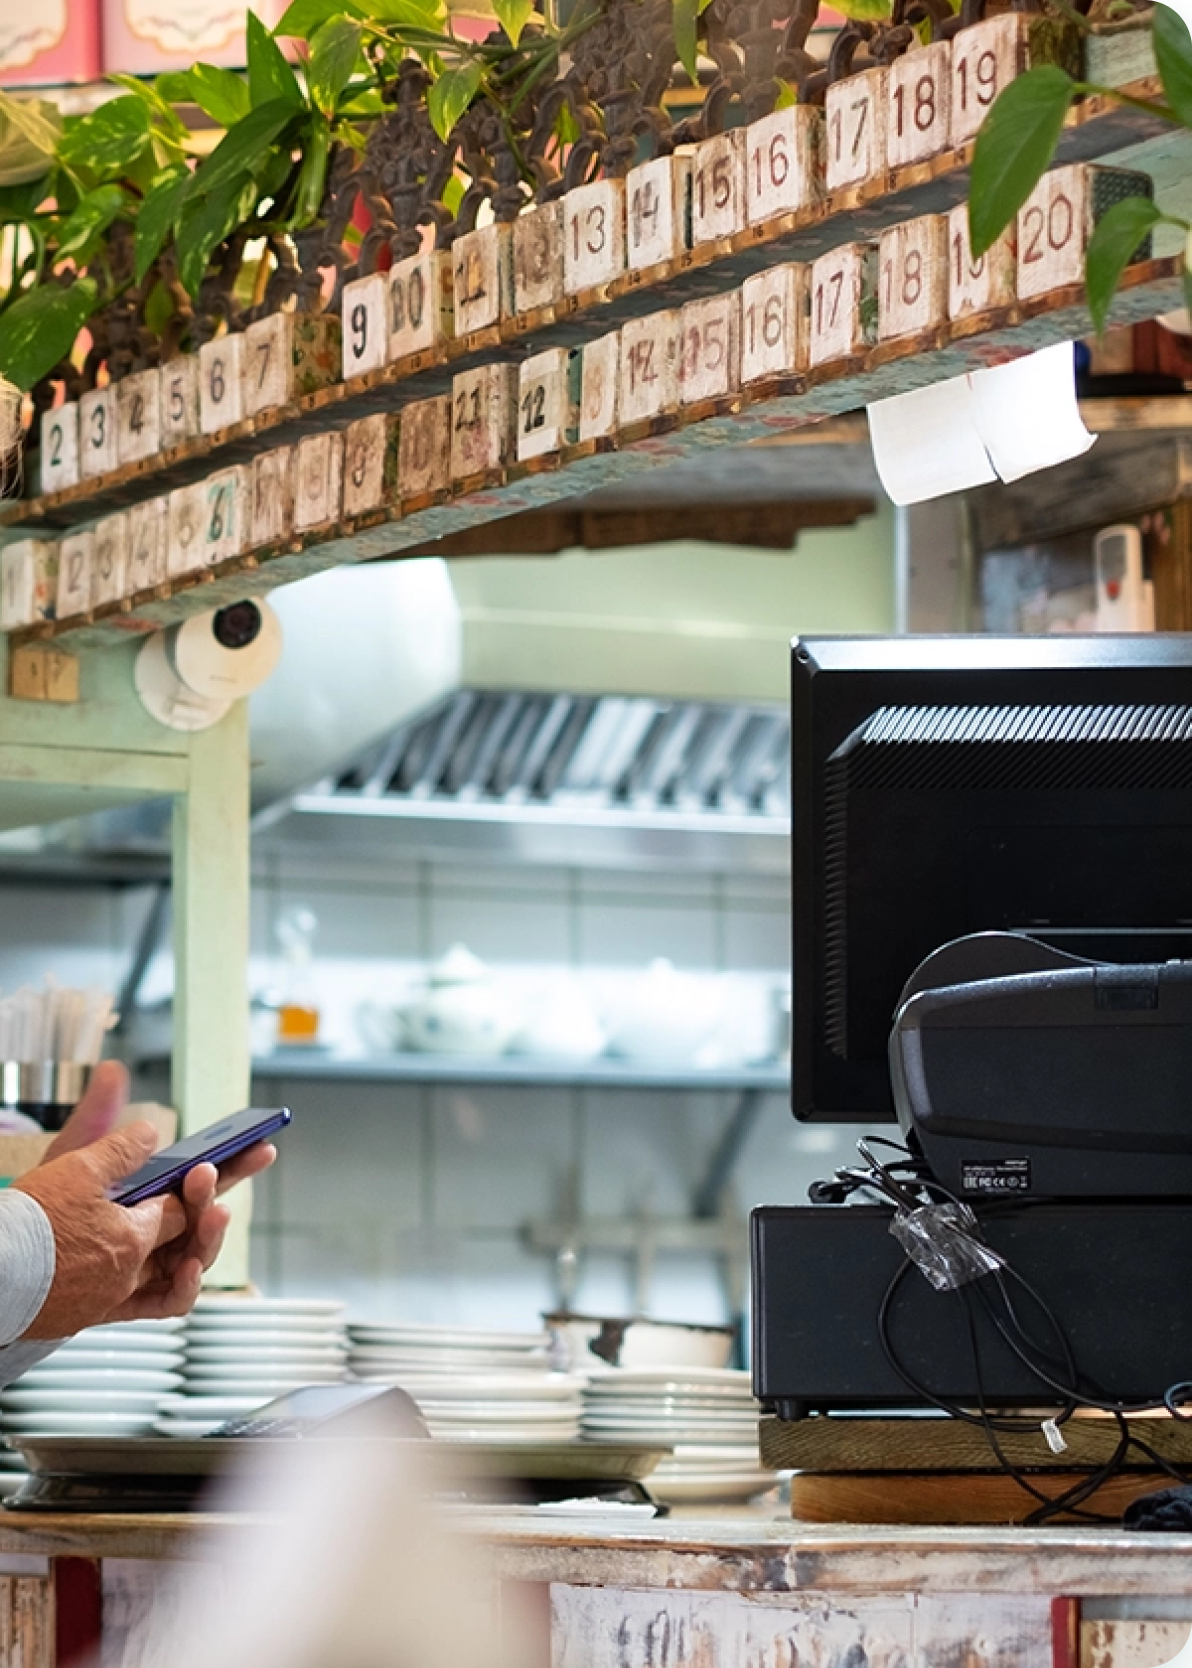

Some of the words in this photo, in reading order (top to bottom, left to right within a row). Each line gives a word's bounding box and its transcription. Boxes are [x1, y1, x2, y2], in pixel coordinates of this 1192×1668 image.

[892, 75, 935, 137] 18
[956, 50, 997, 110] 19
[830, 97, 868, 162] 17
[695, 155, 732, 218] 15
[752, 134, 790, 196] 16
[570, 205, 605, 262] 13
[1022, 194, 1073, 265] 20
[815, 270, 844, 335] 17
[883, 249, 923, 314] 18
[351, 303, 367, 359] 9
[745, 294, 783, 355] 16
[210, 358, 225, 404] 6
[257, 343, 272, 390] 7
[90, 404, 106, 449] 3
[129, 395, 144, 436] 4
[170, 378, 184, 422] 5
[456, 382, 480, 432] 11
[522, 384, 545, 434] 12
[49, 423, 63, 467] 2
[69, 552, 83, 593] 2
